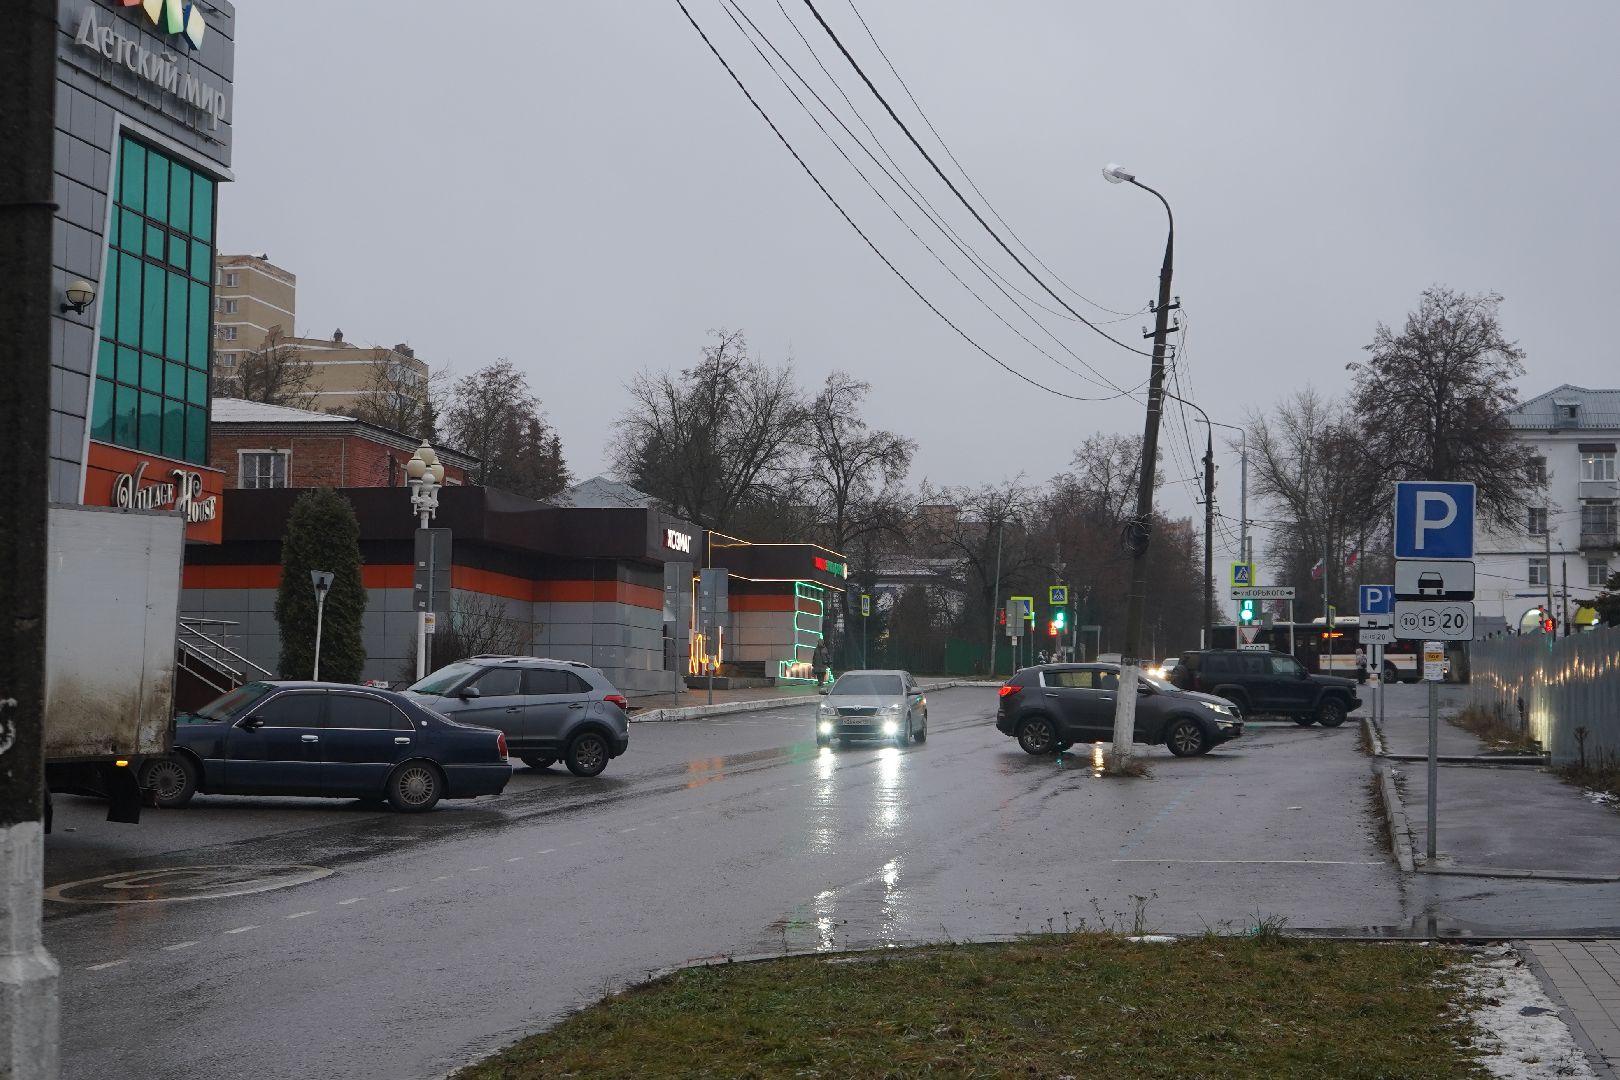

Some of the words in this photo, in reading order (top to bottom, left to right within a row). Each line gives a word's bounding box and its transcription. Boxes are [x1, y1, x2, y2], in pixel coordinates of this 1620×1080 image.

[74, 6, 178, 94] Детский
[180, 73, 226, 131] мир
[1415, 491, 1457, 550] P
[667, 529, 691, 553] ХОЗМАГ
[1367, 588, 1383, 611] P
[1403, 618, 1416, 626] 10
[1421, 615, 1436, 627] 15
[1442, 613, 1464, 629] 20
[1376, 633, 1386, 641] 20
